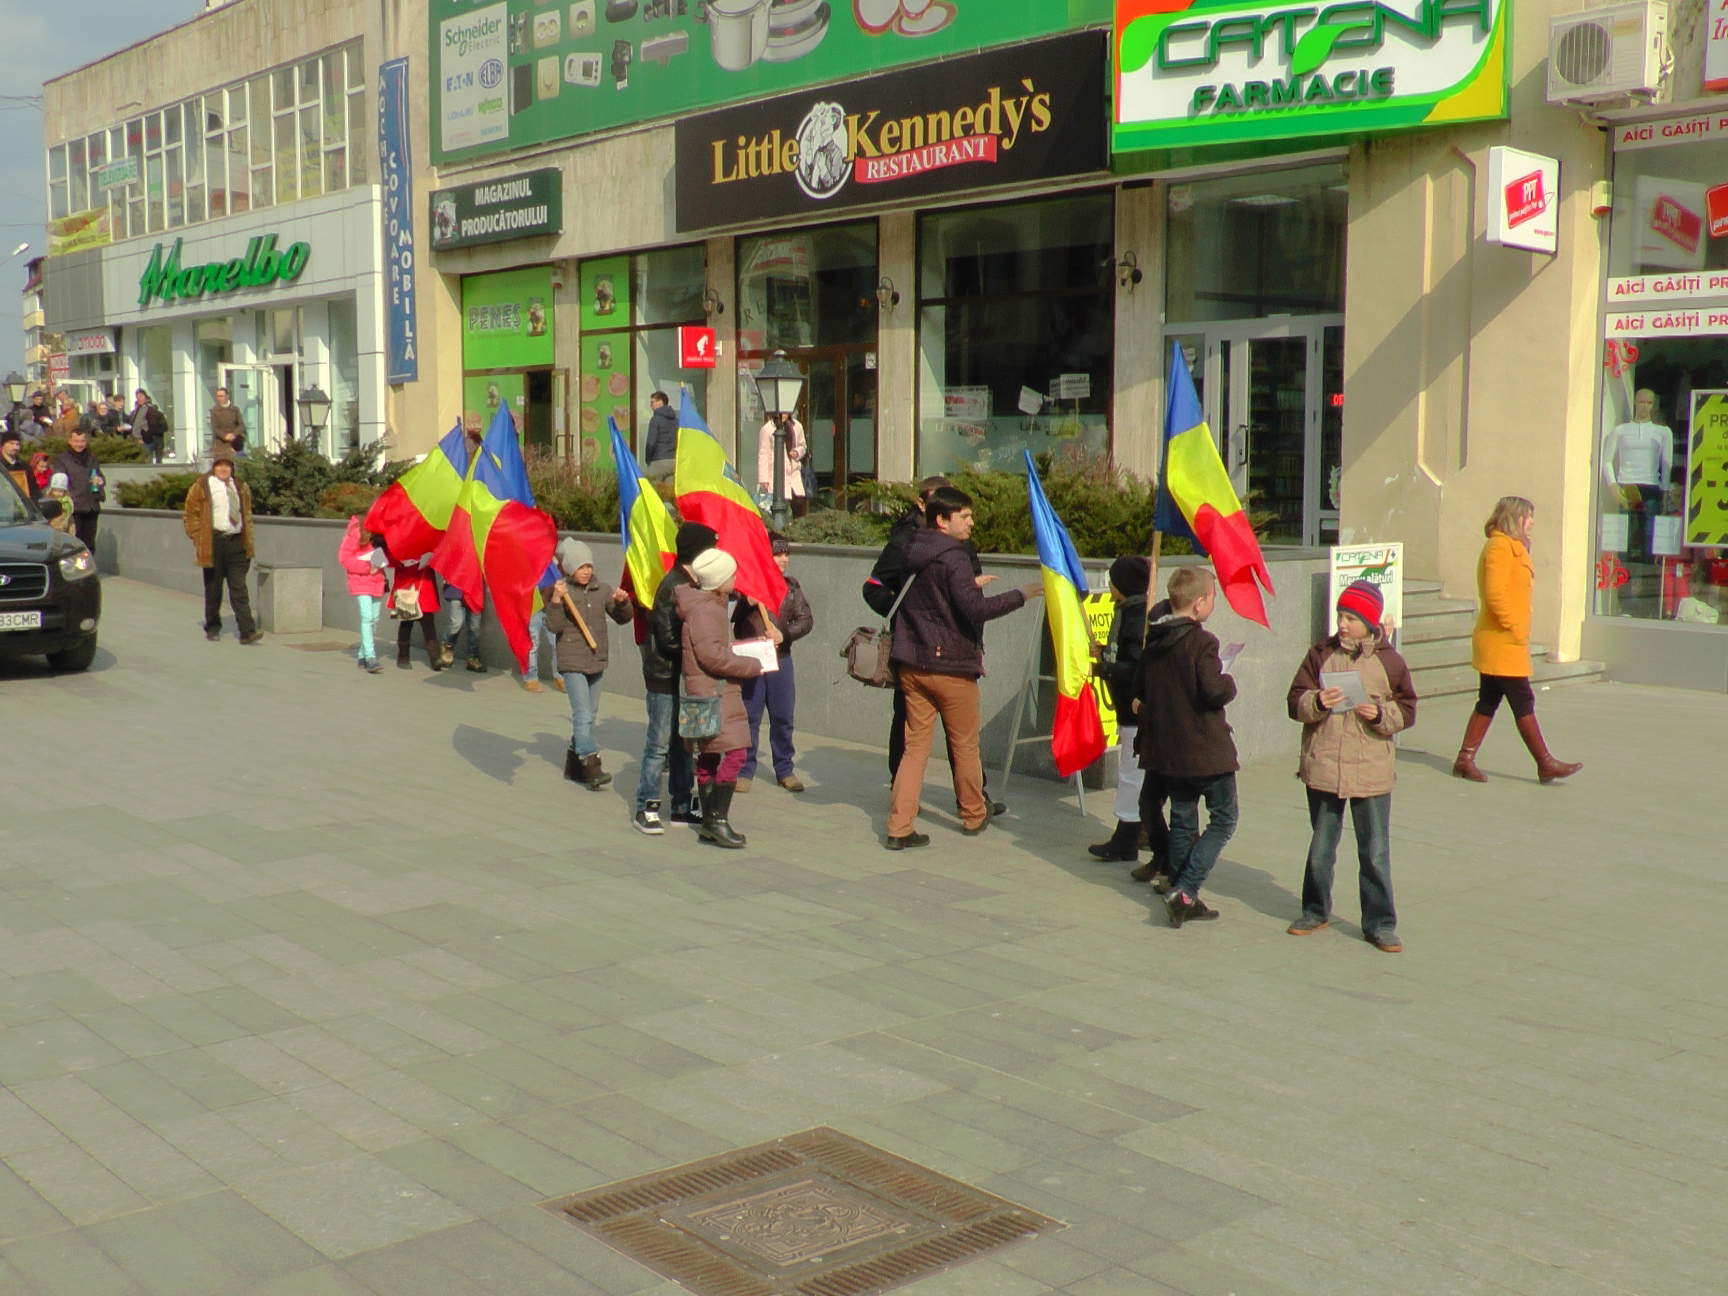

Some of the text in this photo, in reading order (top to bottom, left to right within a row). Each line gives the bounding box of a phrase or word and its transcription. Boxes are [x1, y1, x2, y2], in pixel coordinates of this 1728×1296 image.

[445, 17, 502, 47] Schneider
[468, 35, 500, 53] Electric
[1158, 0, 1491, 69] CATENA
[1193, 66, 1396, 112] FARMACIE
[379, 75, 389, 225] MOCHETE
[712, 78, 1052, 184] Little Kennedy's
[867, 137, 989, 180] RESTAURANT
[475, 178, 532, 206] MAGAZINUL
[389, 151, 400, 305] COVOARE
[461, 204, 548, 237] PRODUCĂTORULUI
[137, 232, 311, 305] Marelbo
[1709, 276, 1728, 289] PR
[399, 229, 416, 361] MOBILĂ
[1708, 314, 1728, 326] PR
[1710, 413, 1728, 427] PR
[1341, 550, 1384, 562] CATENA
